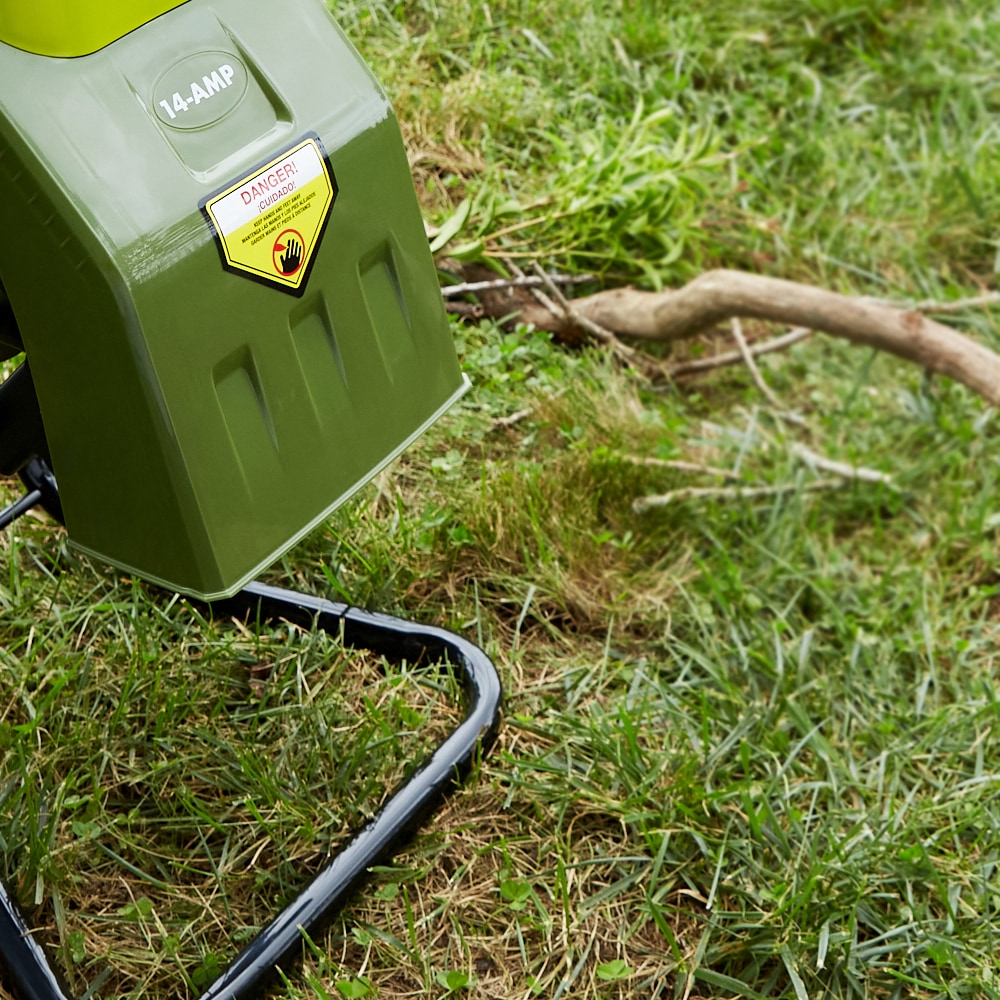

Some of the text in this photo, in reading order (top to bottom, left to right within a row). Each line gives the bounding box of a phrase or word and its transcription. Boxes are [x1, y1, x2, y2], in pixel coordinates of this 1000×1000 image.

[159, 64, 234, 119] 14-AMP
[240, 161, 299, 206] DANGER!
[258, 181, 297, 213] ¡CUIDADO!
[241, 228, 261, 243] MANTENGA
[261, 222, 269, 230] LAS
[268, 214, 281, 225] MANOS
[251, 233, 265, 246] GARDER
[265, 225, 276, 236] MAINS
[295, 202, 311, 216] DISTANCE
[254, 193, 300, 227] KEEP HANDS AND FEET AWAY
